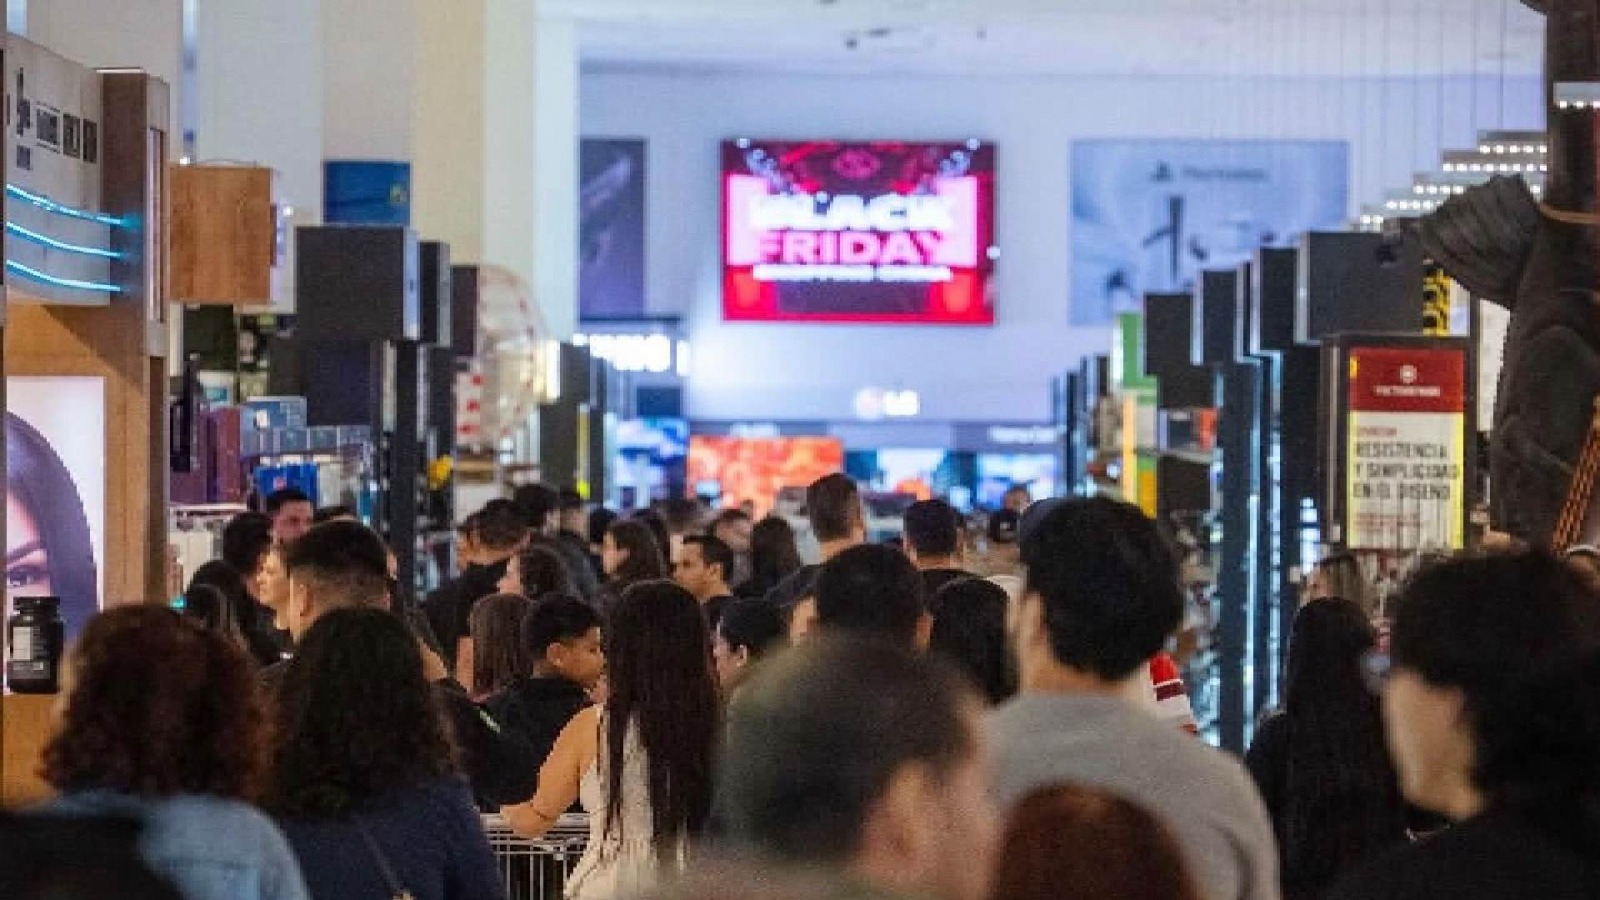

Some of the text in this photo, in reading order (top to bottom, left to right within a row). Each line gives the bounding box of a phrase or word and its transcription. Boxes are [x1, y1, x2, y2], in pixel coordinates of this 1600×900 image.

[751, 194, 952, 230] BLACK
[760, 230, 943, 264] FRIDAY
[1355, 441, 1447, 457] RESISTENCIA
